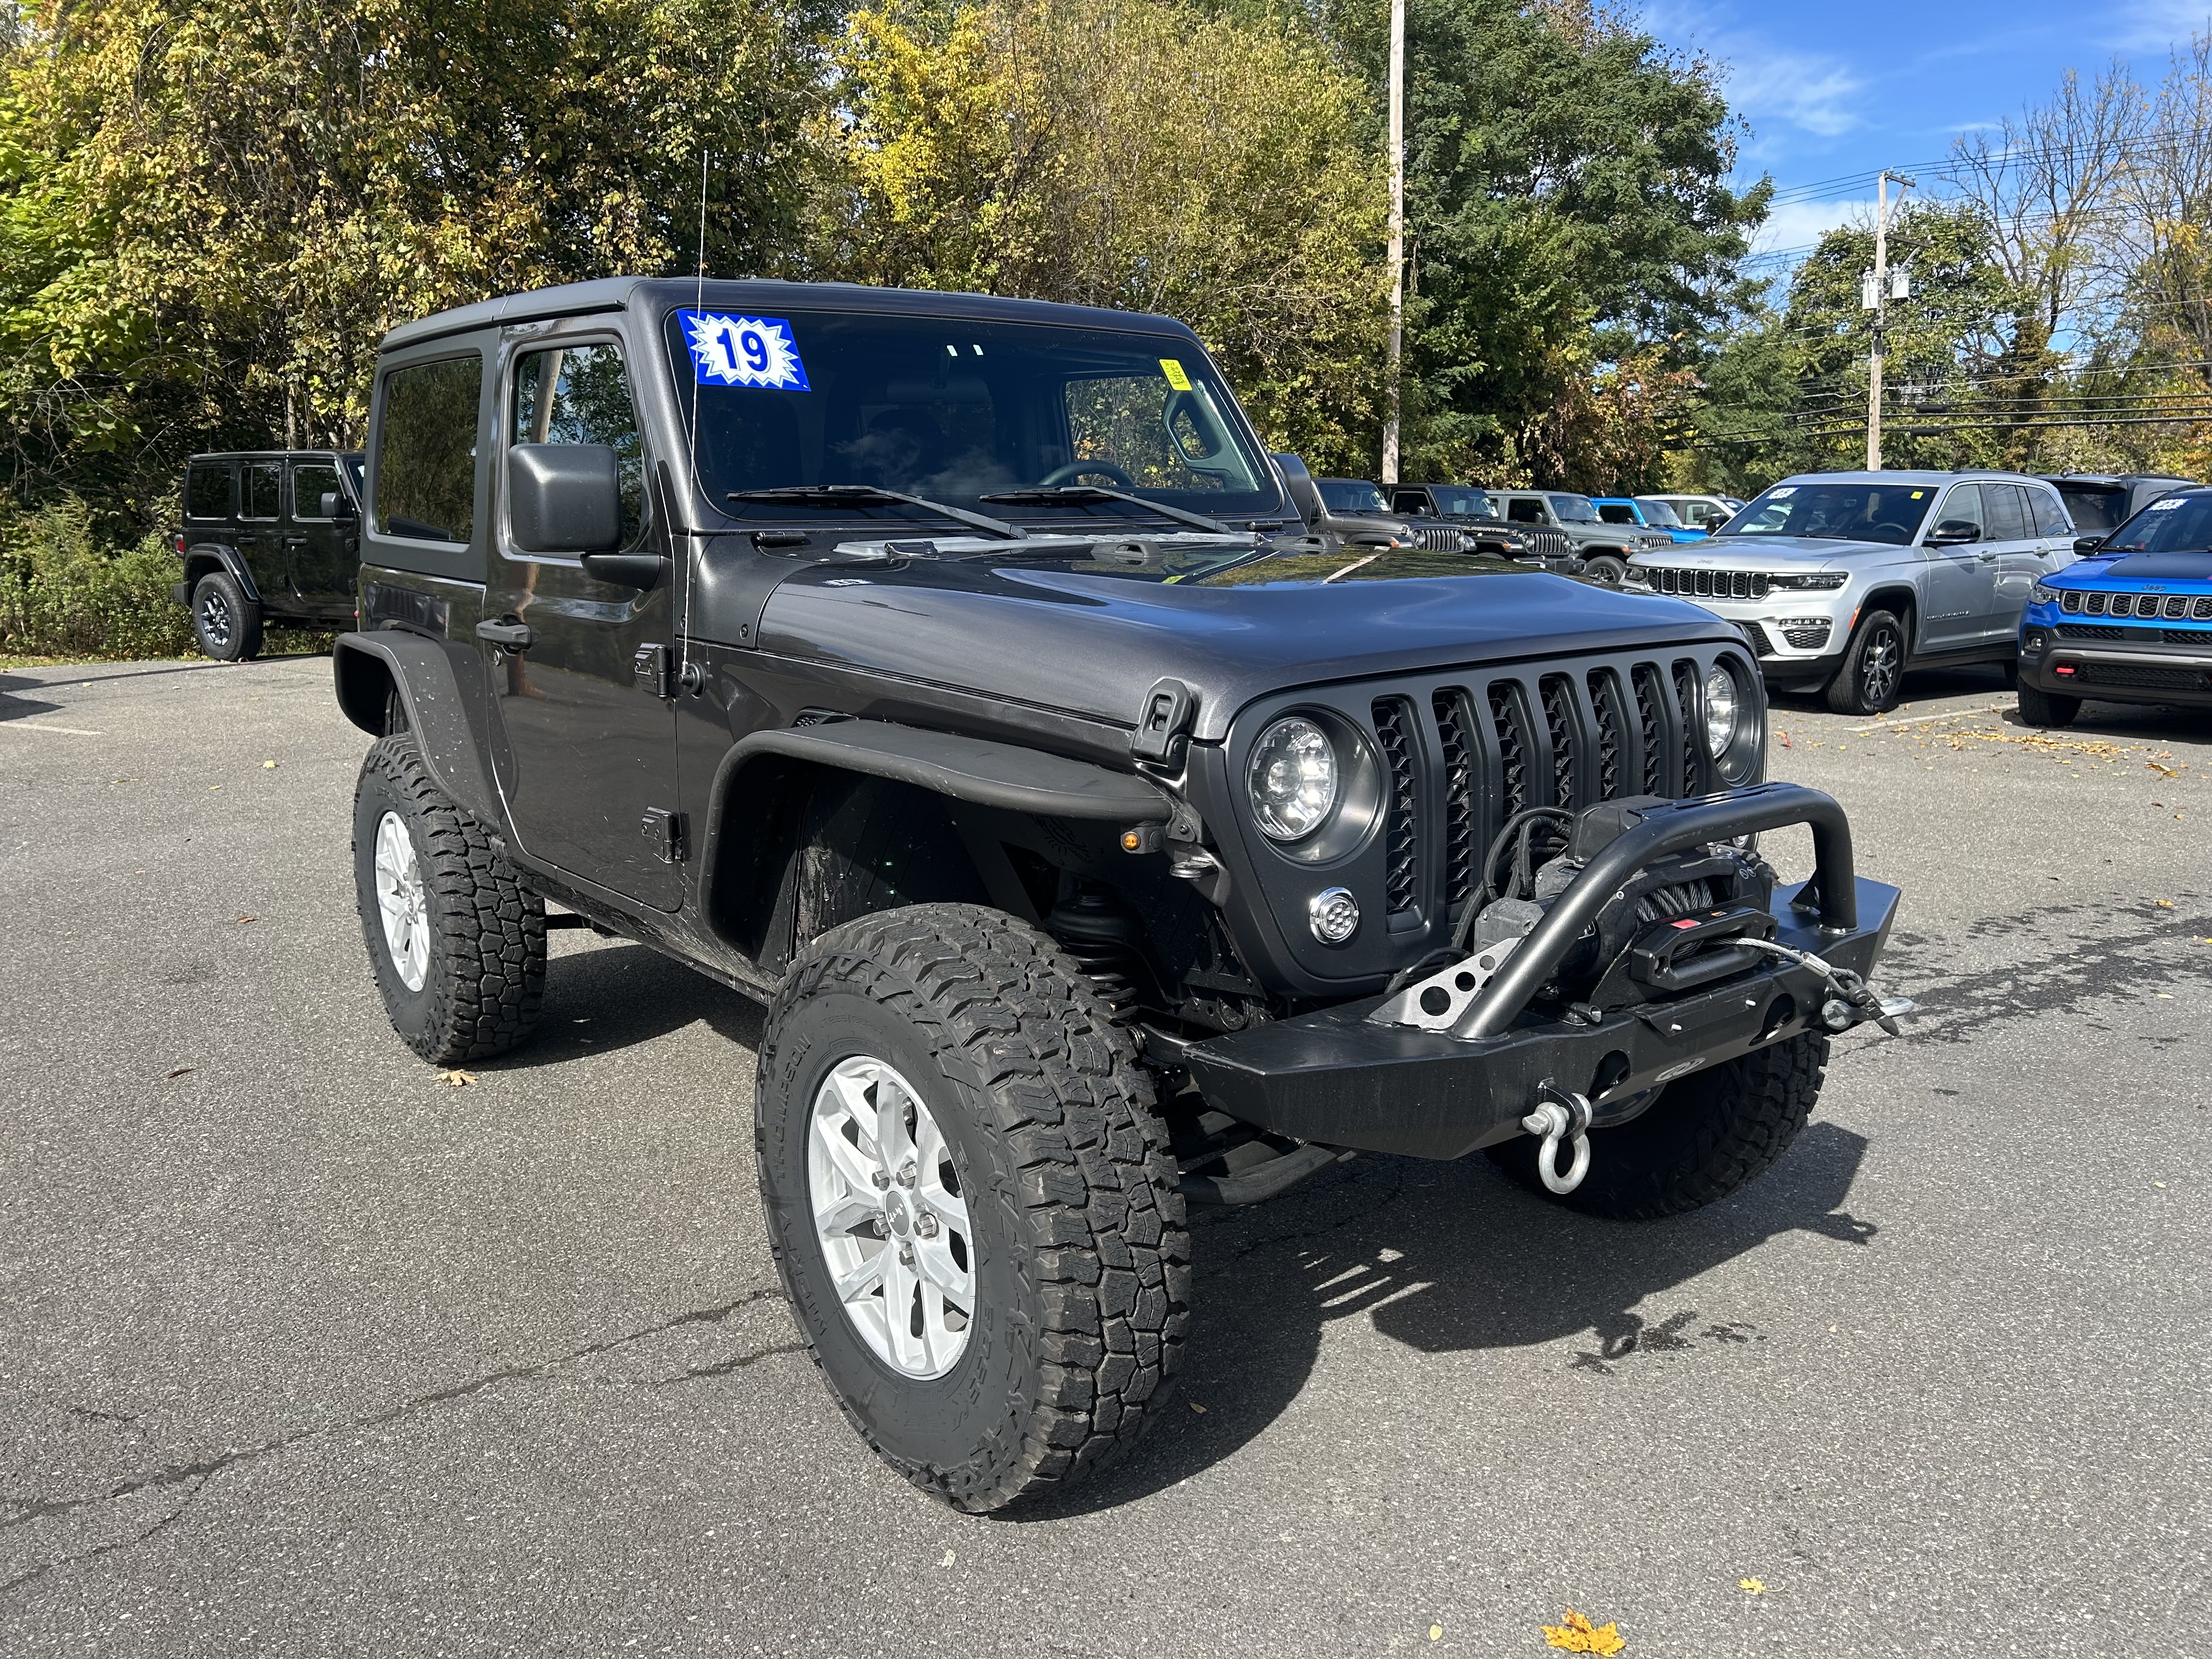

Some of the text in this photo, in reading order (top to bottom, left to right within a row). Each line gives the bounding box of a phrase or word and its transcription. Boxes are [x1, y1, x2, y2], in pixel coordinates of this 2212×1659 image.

[716, 328, 769, 373] 19
[2141, 584, 2166, 592] Jeep
[773, 1032, 811, 1183] THOMPSON
